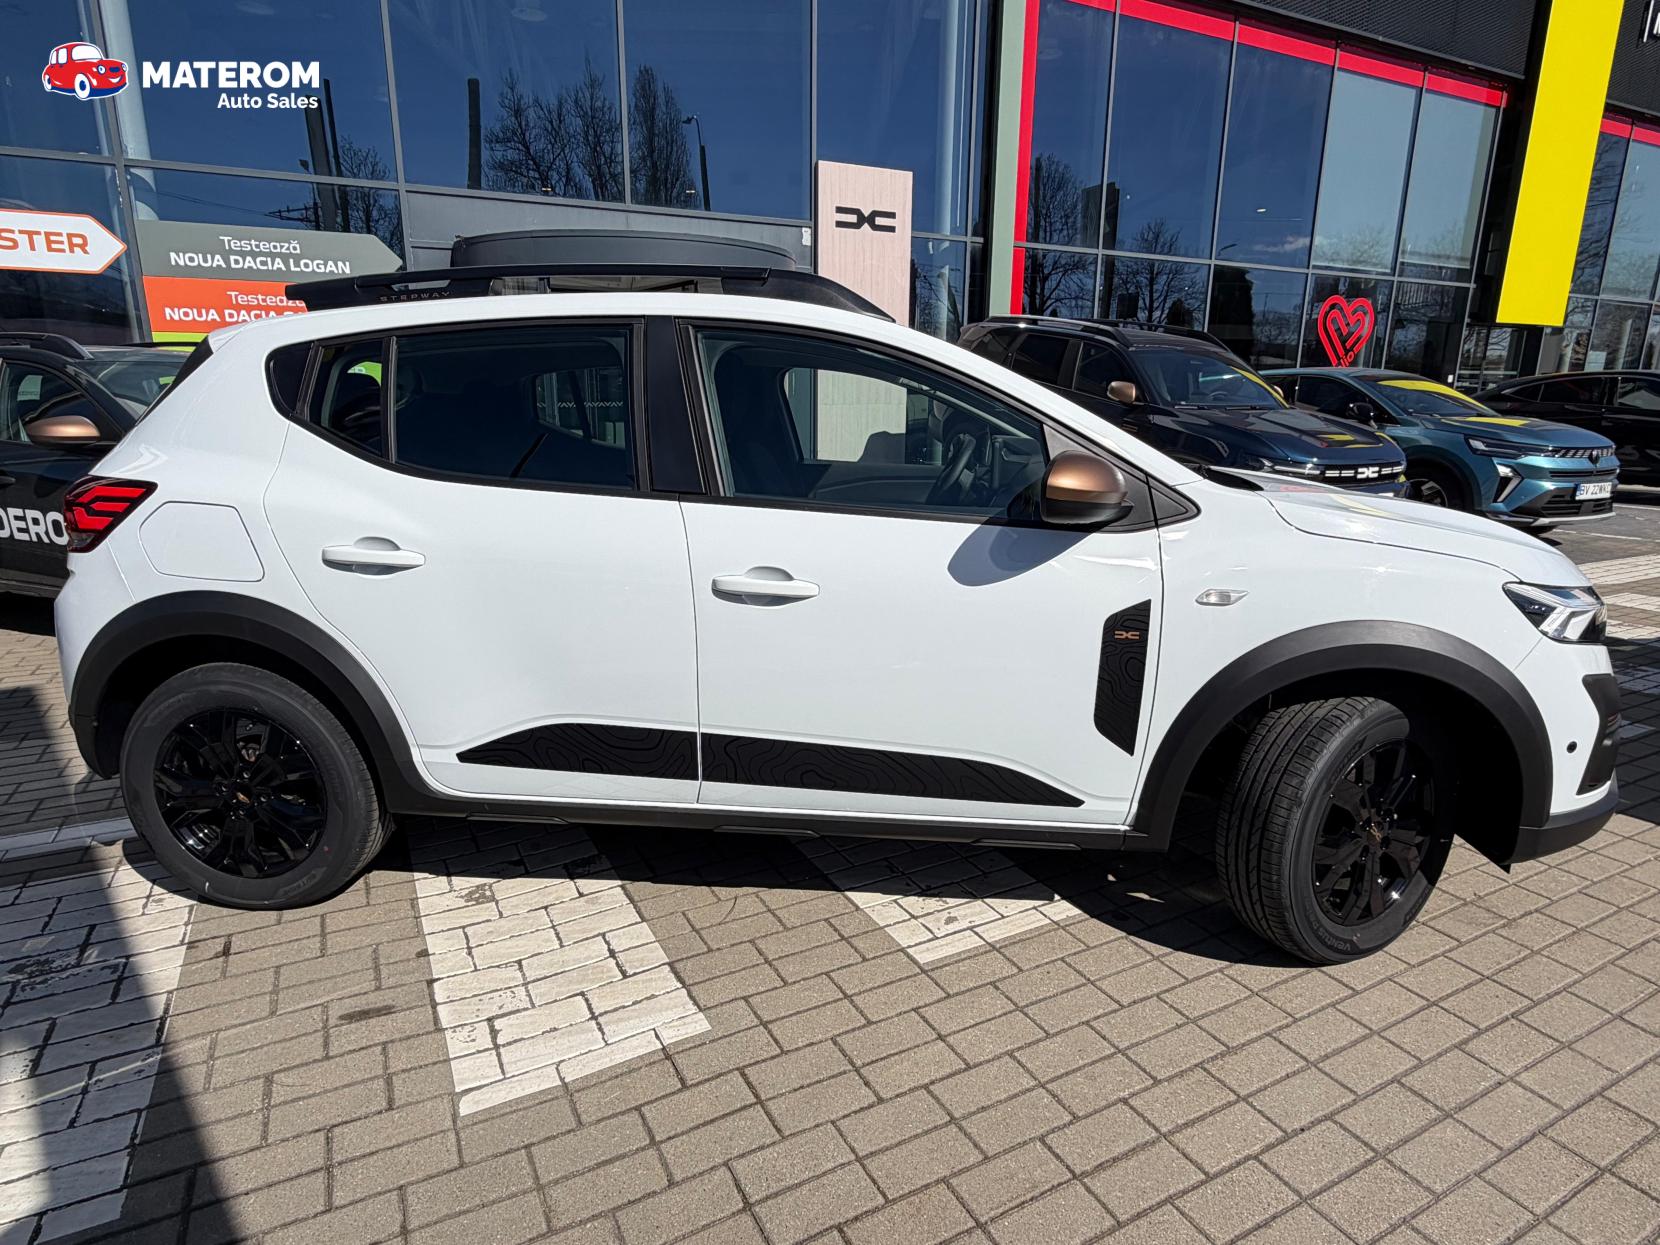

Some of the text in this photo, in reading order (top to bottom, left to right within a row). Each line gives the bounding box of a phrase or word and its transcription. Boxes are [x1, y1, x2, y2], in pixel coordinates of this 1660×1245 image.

[219, 236, 301, 254] Testează
[169, 252, 351, 274] NOUA DACIA LOGAN
[379, 291, 450, 302] STEPWAY
[164, 307, 221, 322] NOUA
